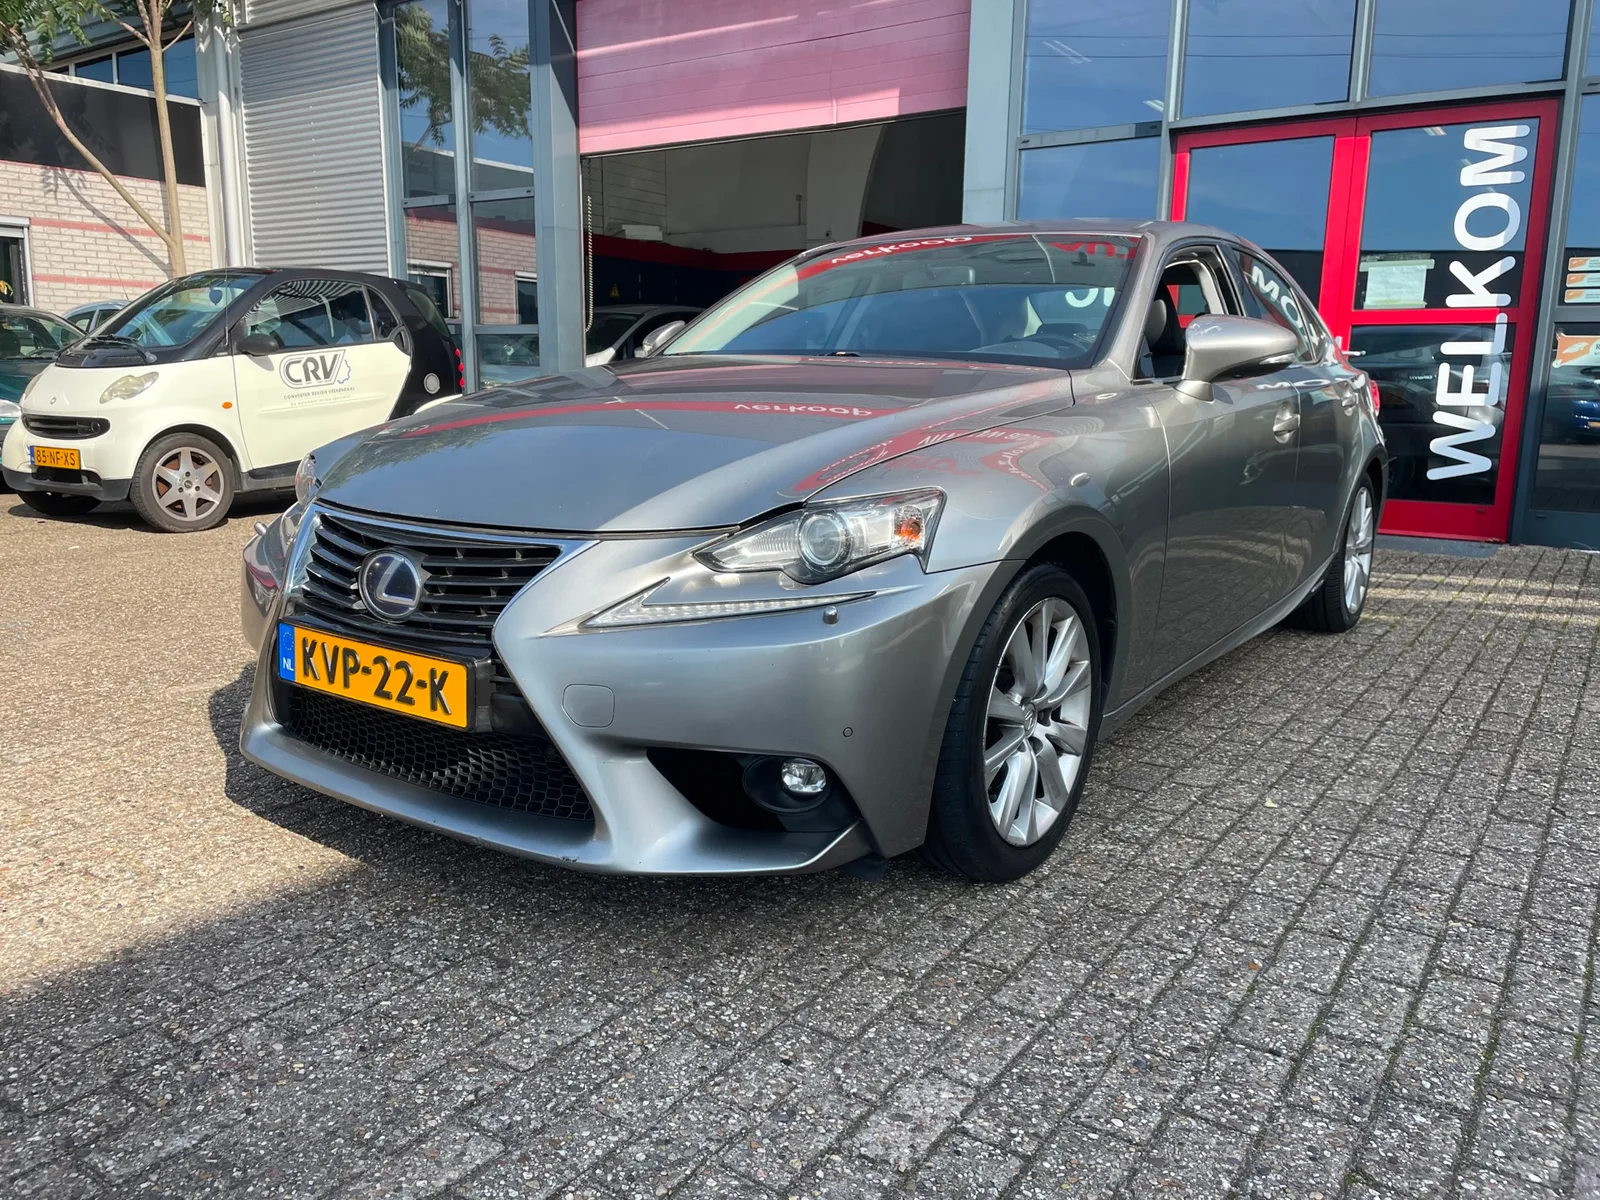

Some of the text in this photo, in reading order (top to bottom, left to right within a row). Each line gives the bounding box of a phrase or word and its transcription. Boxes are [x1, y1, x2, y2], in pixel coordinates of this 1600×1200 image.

[1426, 124, 1531, 481] WELKOM
[284, 353, 339, 384] CRV
[36, 449, 76, 466] 85-NF-XS
[282, 657, 295, 672] NL
[302, 637, 453, 715] KVP-22-K
